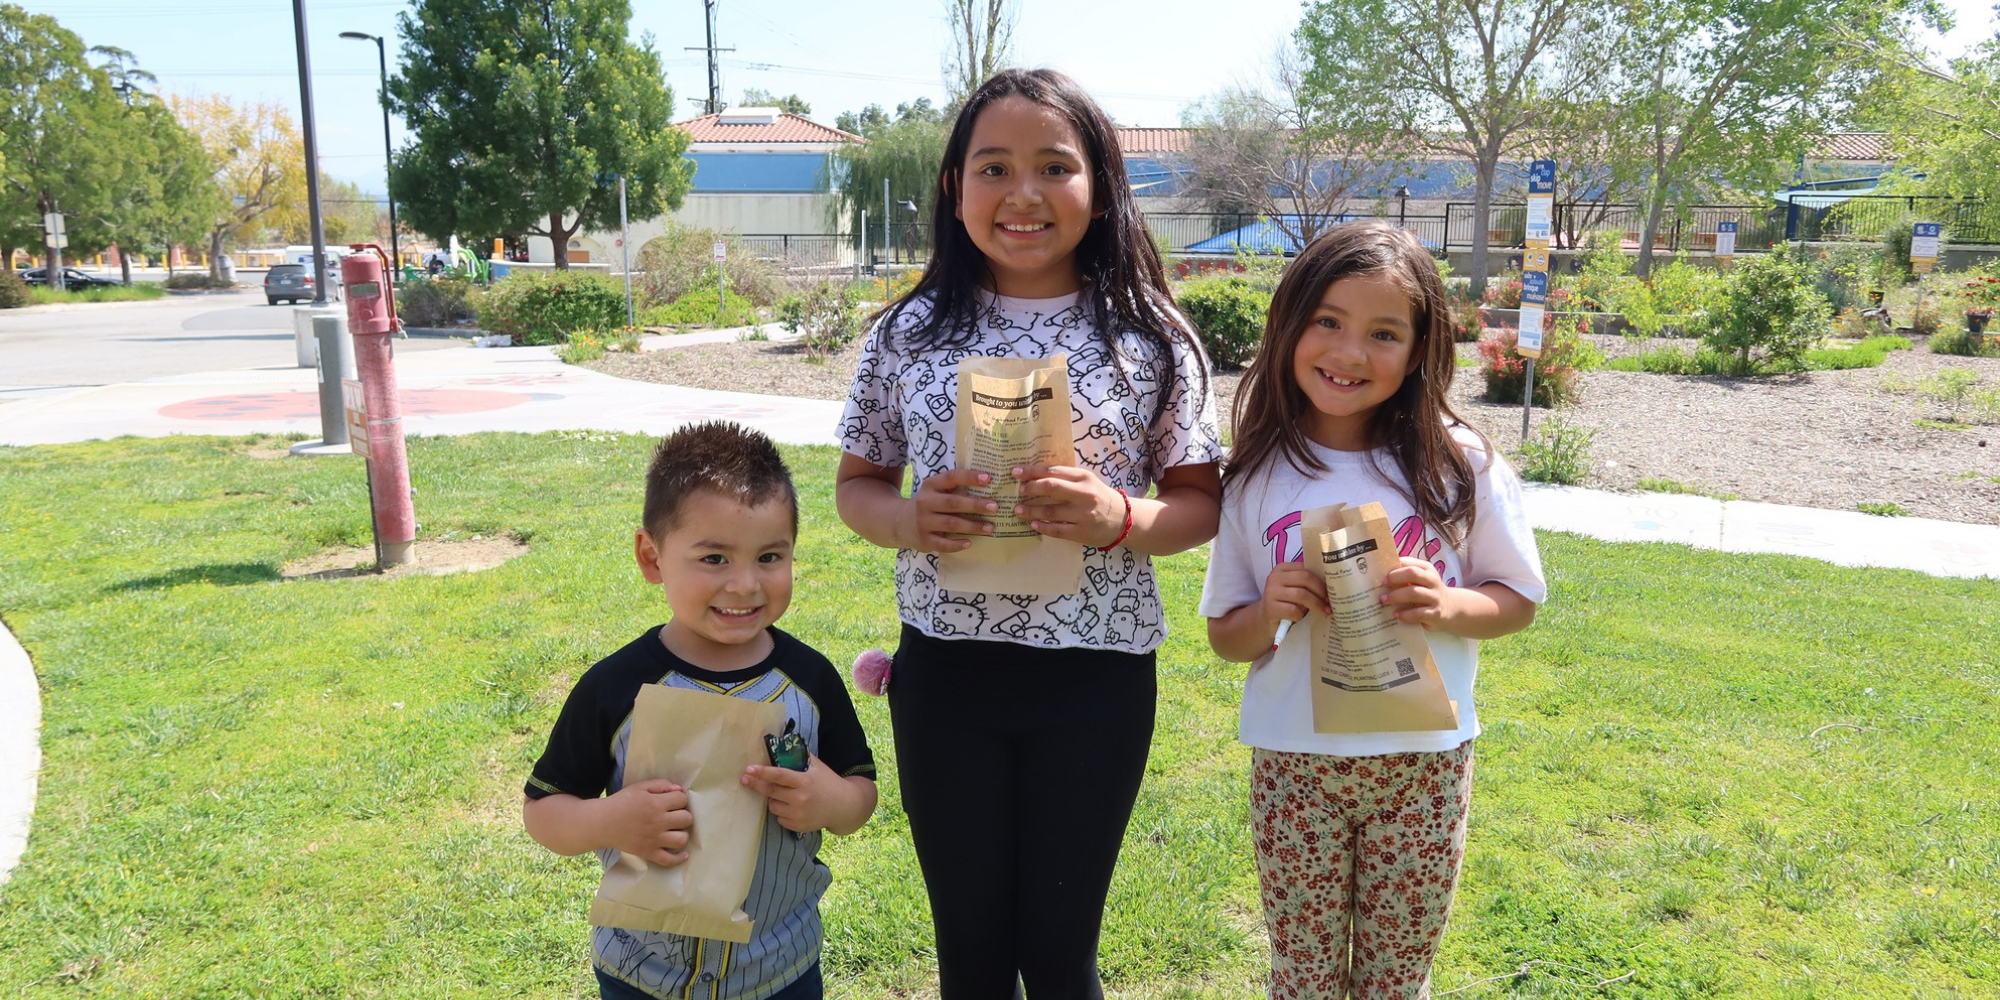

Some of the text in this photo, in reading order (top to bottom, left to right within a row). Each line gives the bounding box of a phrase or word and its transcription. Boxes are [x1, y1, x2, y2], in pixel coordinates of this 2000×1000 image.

[1530, 173, 1541, 184] skip
[1537, 181, 1553, 190] move
[975, 394, 996, 407] Brought
[995, 399, 1003, 407] to
[1002, 401, 1018, 409] you
[1324, 553, 1338, 563] you
